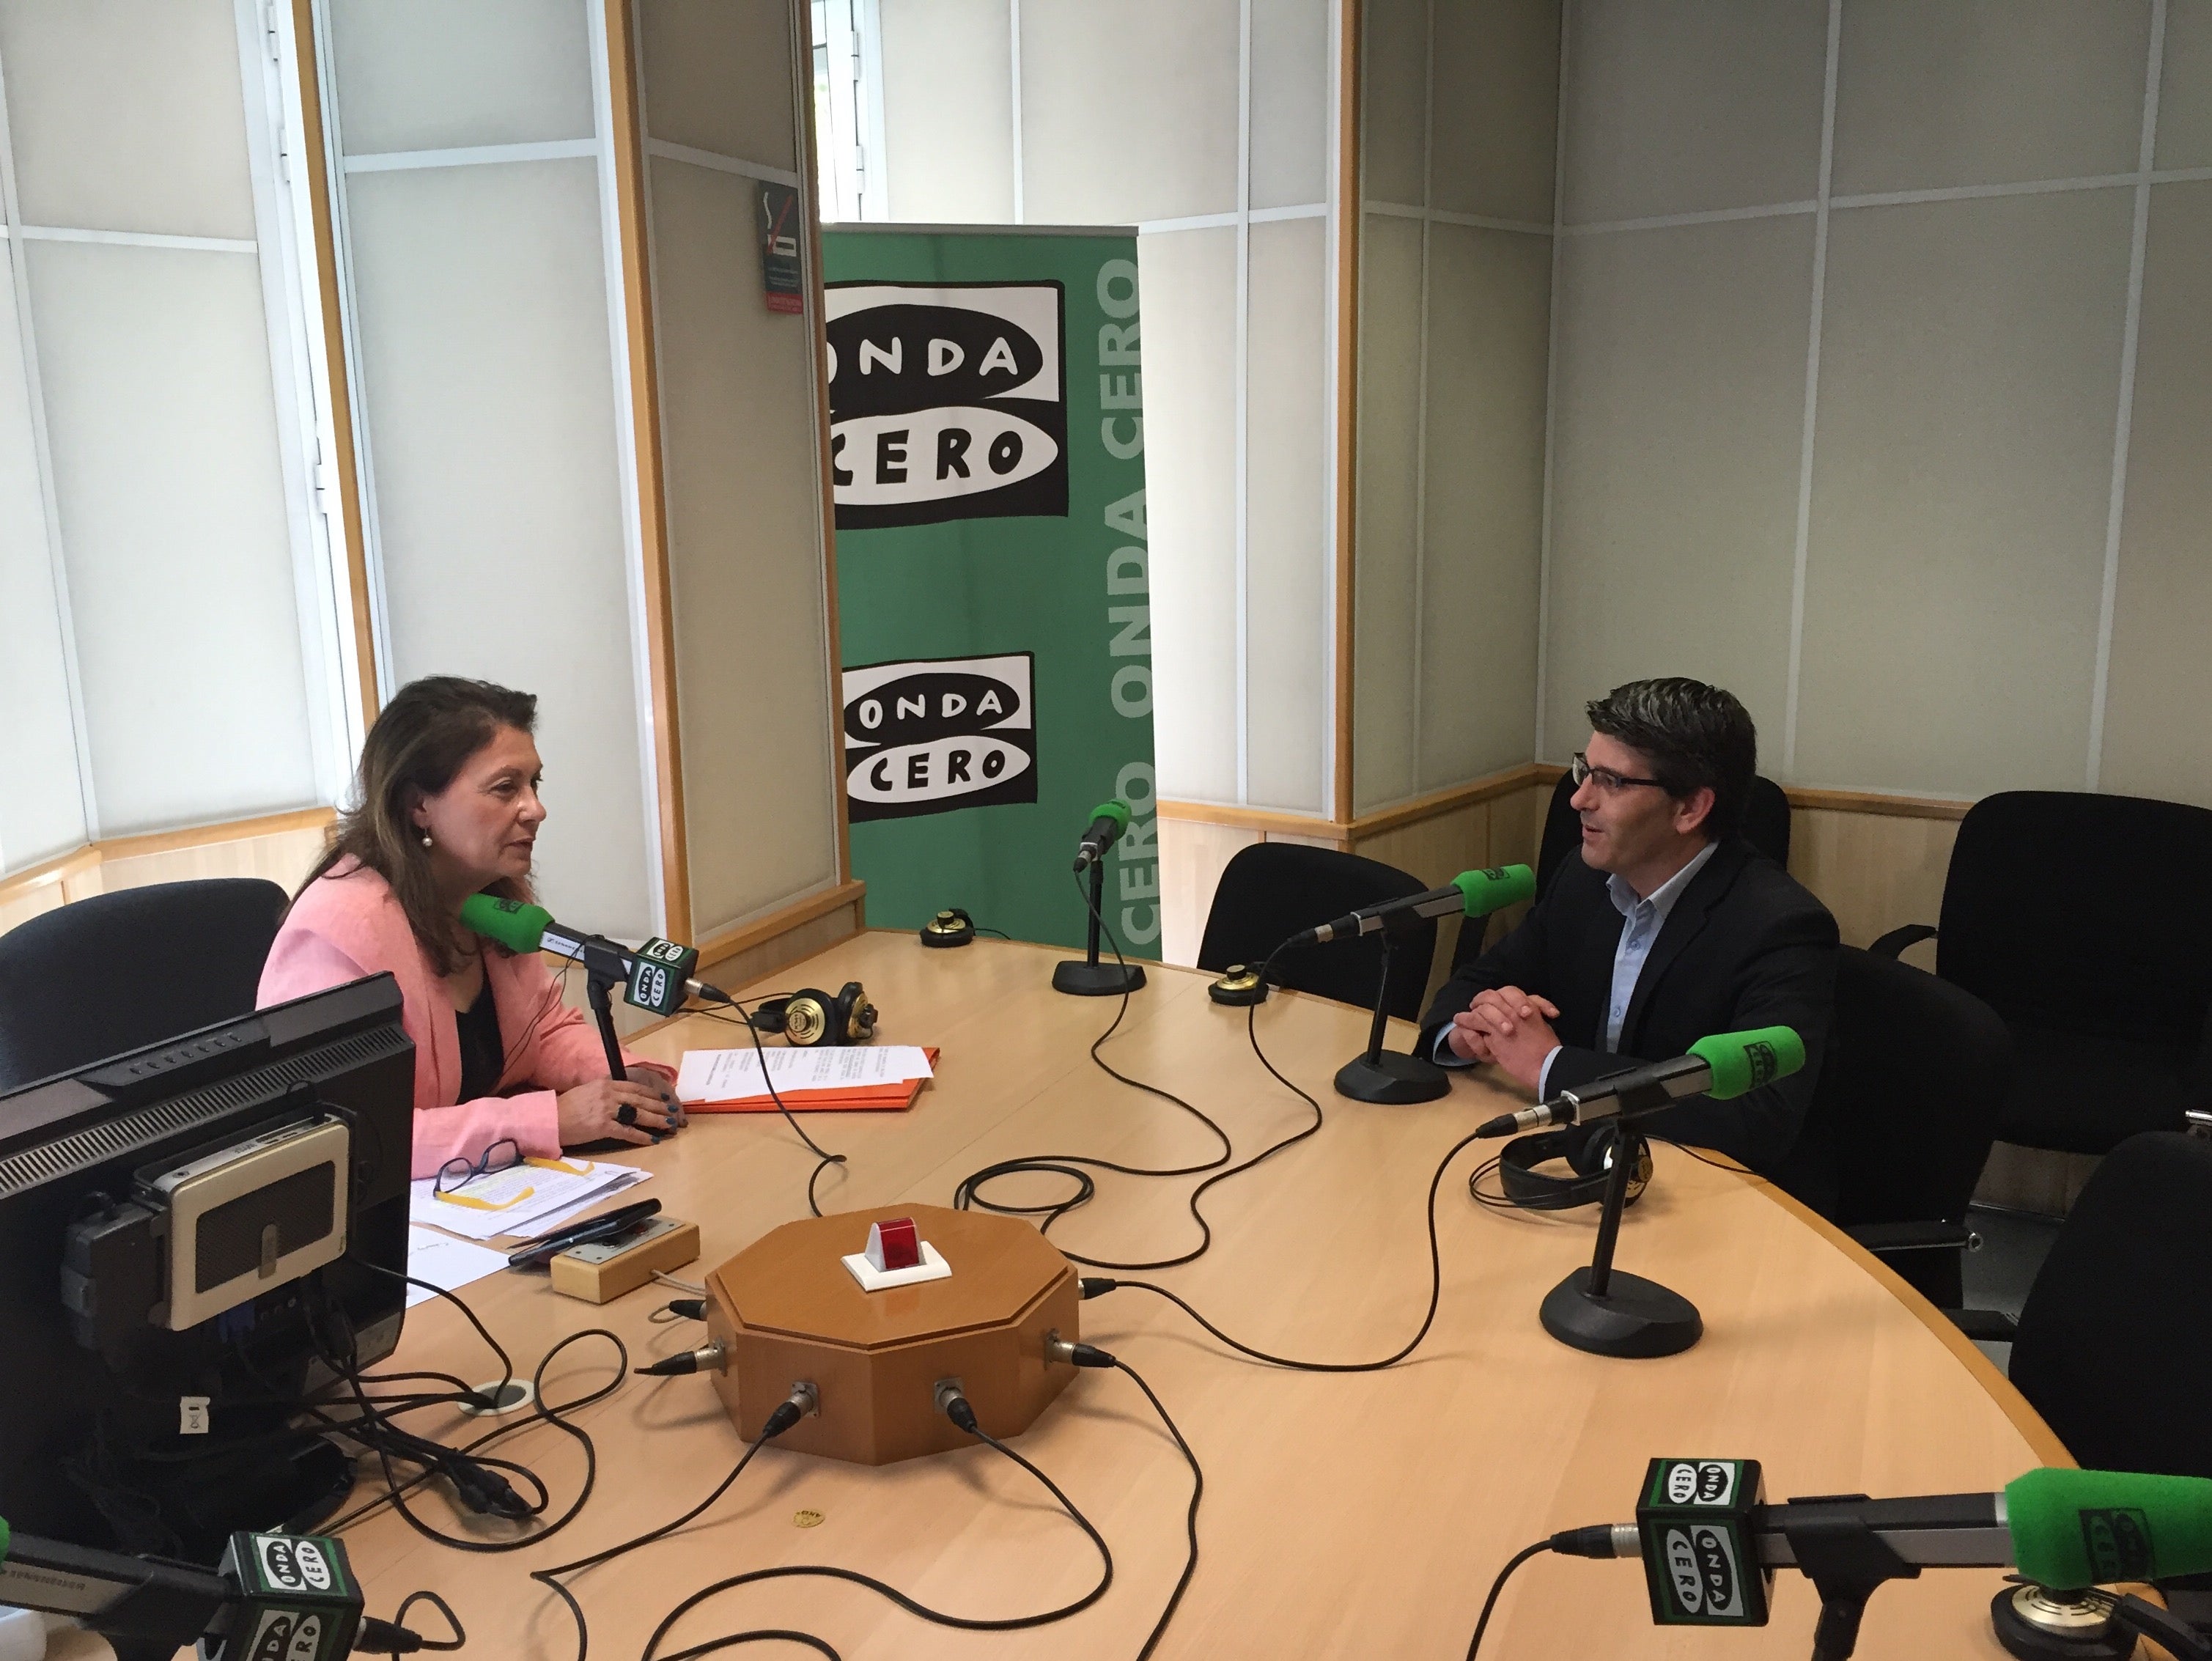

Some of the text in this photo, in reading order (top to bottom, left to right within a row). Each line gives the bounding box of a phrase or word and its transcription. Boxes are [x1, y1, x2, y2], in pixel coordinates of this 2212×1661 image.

[831, 427, 1024, 487] CERO
[1096, 258, 1161, 946] CERO ONDA CERO
[858, 689, 1003, 729] ONDA
[870, 749, 1006, 792] CERO
[640, 970, 652, 999] ONDA
[652, 973, 664, 1001] CERO
[1673, 1468, 1692, 1499] CERO
[1702, 1467, 1722, 1500] ONDA
[273, 1544, 296, 1583] ONDA
[301, 1547, 325, 1583] CERO
[1672, 1540, 1697, 1603] CERO
[1702, 1536, 1726, 1603] ONDA
